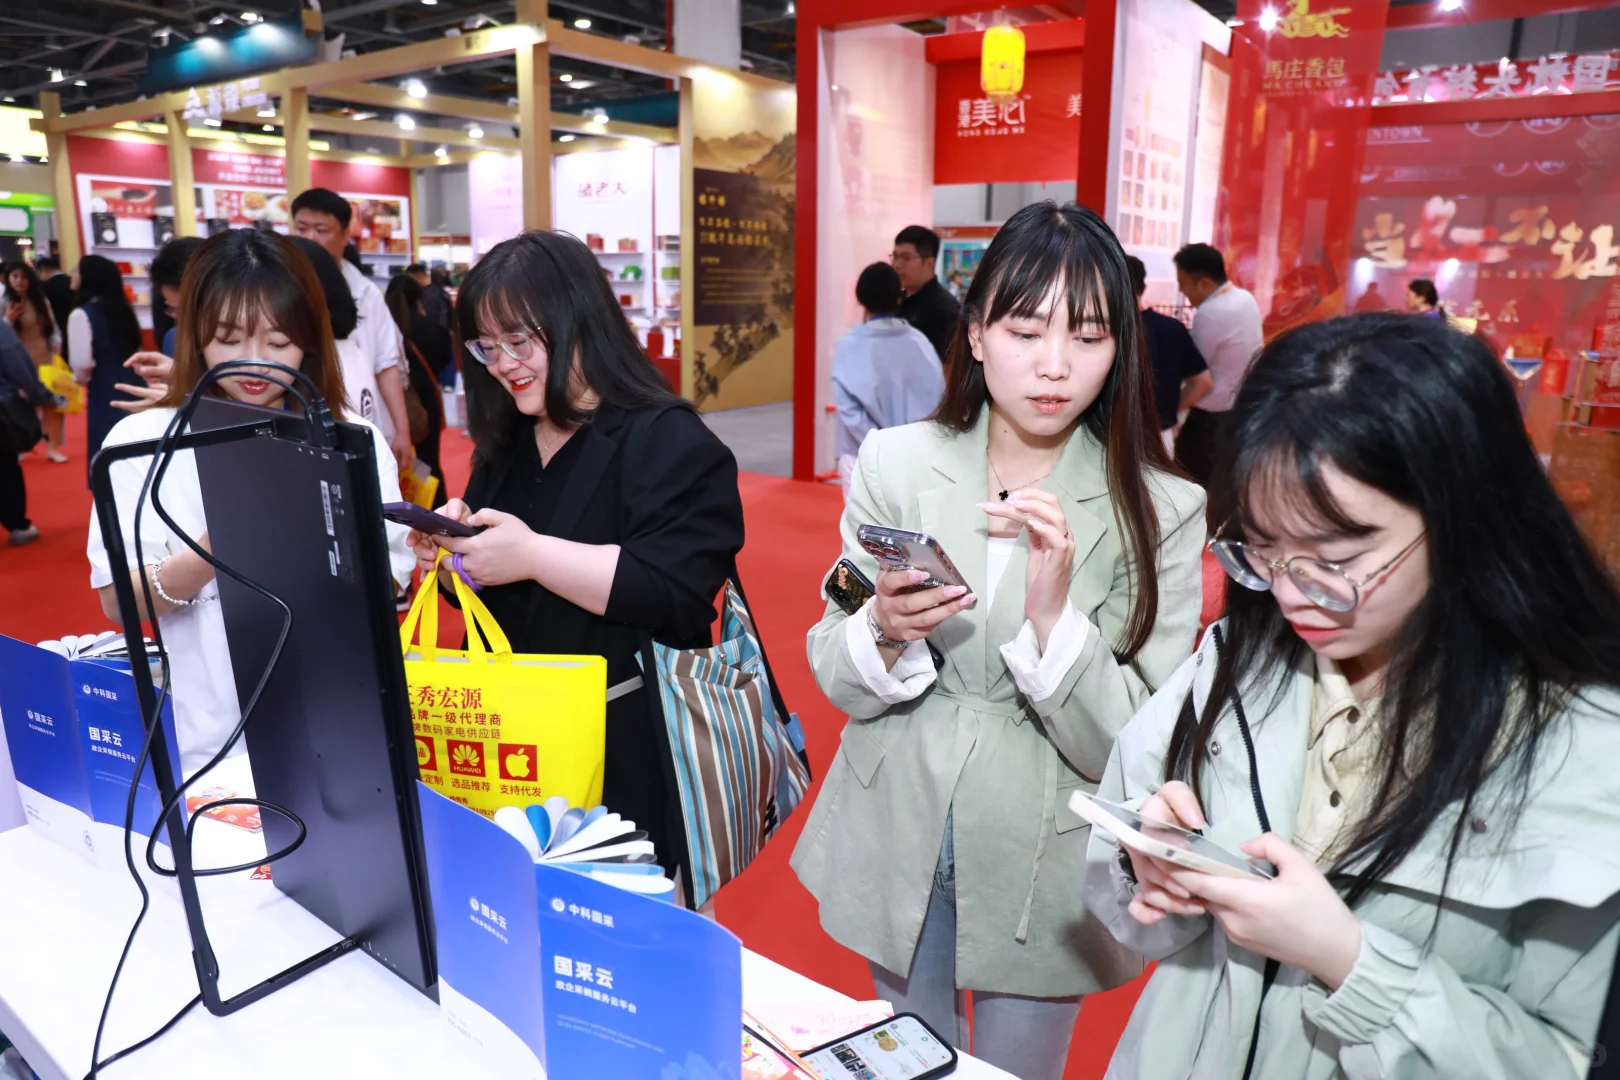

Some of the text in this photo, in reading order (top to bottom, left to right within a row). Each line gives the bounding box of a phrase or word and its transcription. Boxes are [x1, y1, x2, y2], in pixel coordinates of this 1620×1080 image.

[93, 686, 118, 701] 中科国采
[88, 726, 123, 747] 国采云
[453, 765, 482, 774] HUAWEI
[451, 778, 491, 792] 选品推荐
[499, 784, 542, 797] 支持代发
[480, 903, 508, 930] 国采云
[569, 903, 615, 928] 中科国采
[554, 954, 614, 990] 国采云
